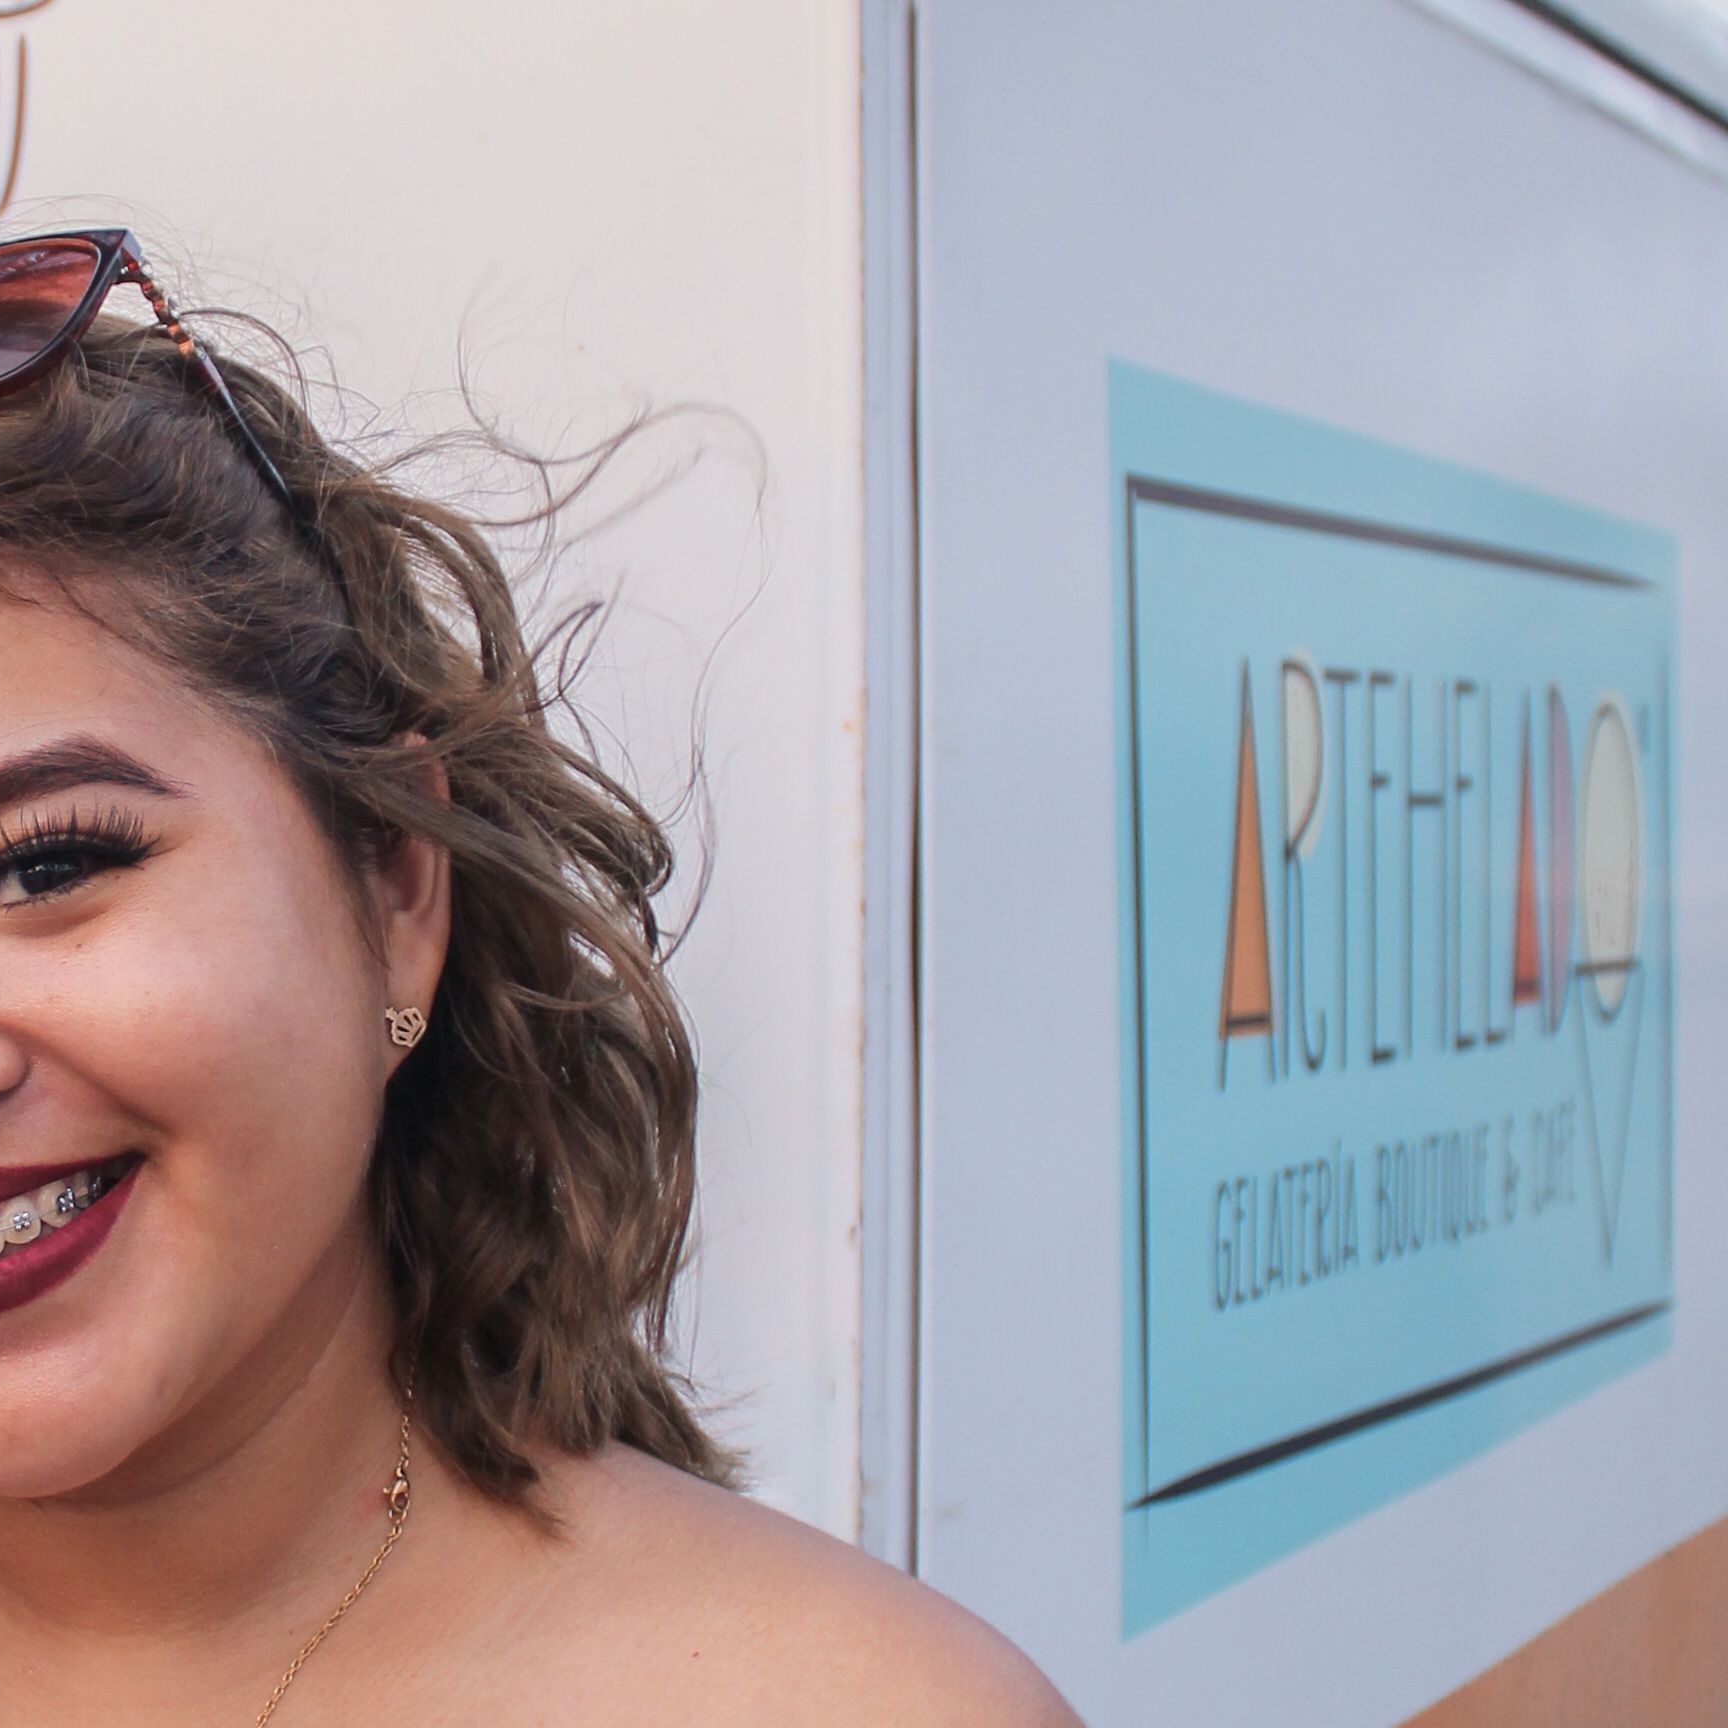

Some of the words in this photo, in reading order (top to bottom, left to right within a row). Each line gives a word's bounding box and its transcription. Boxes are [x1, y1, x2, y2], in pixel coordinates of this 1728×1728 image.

[1218, 656, 1643, 1092] ARTEHELADO
[1212, 1136, 1361, 1312] GELATERÍA
[1373, 1120, 1490, 1265] BOUTIQUE
